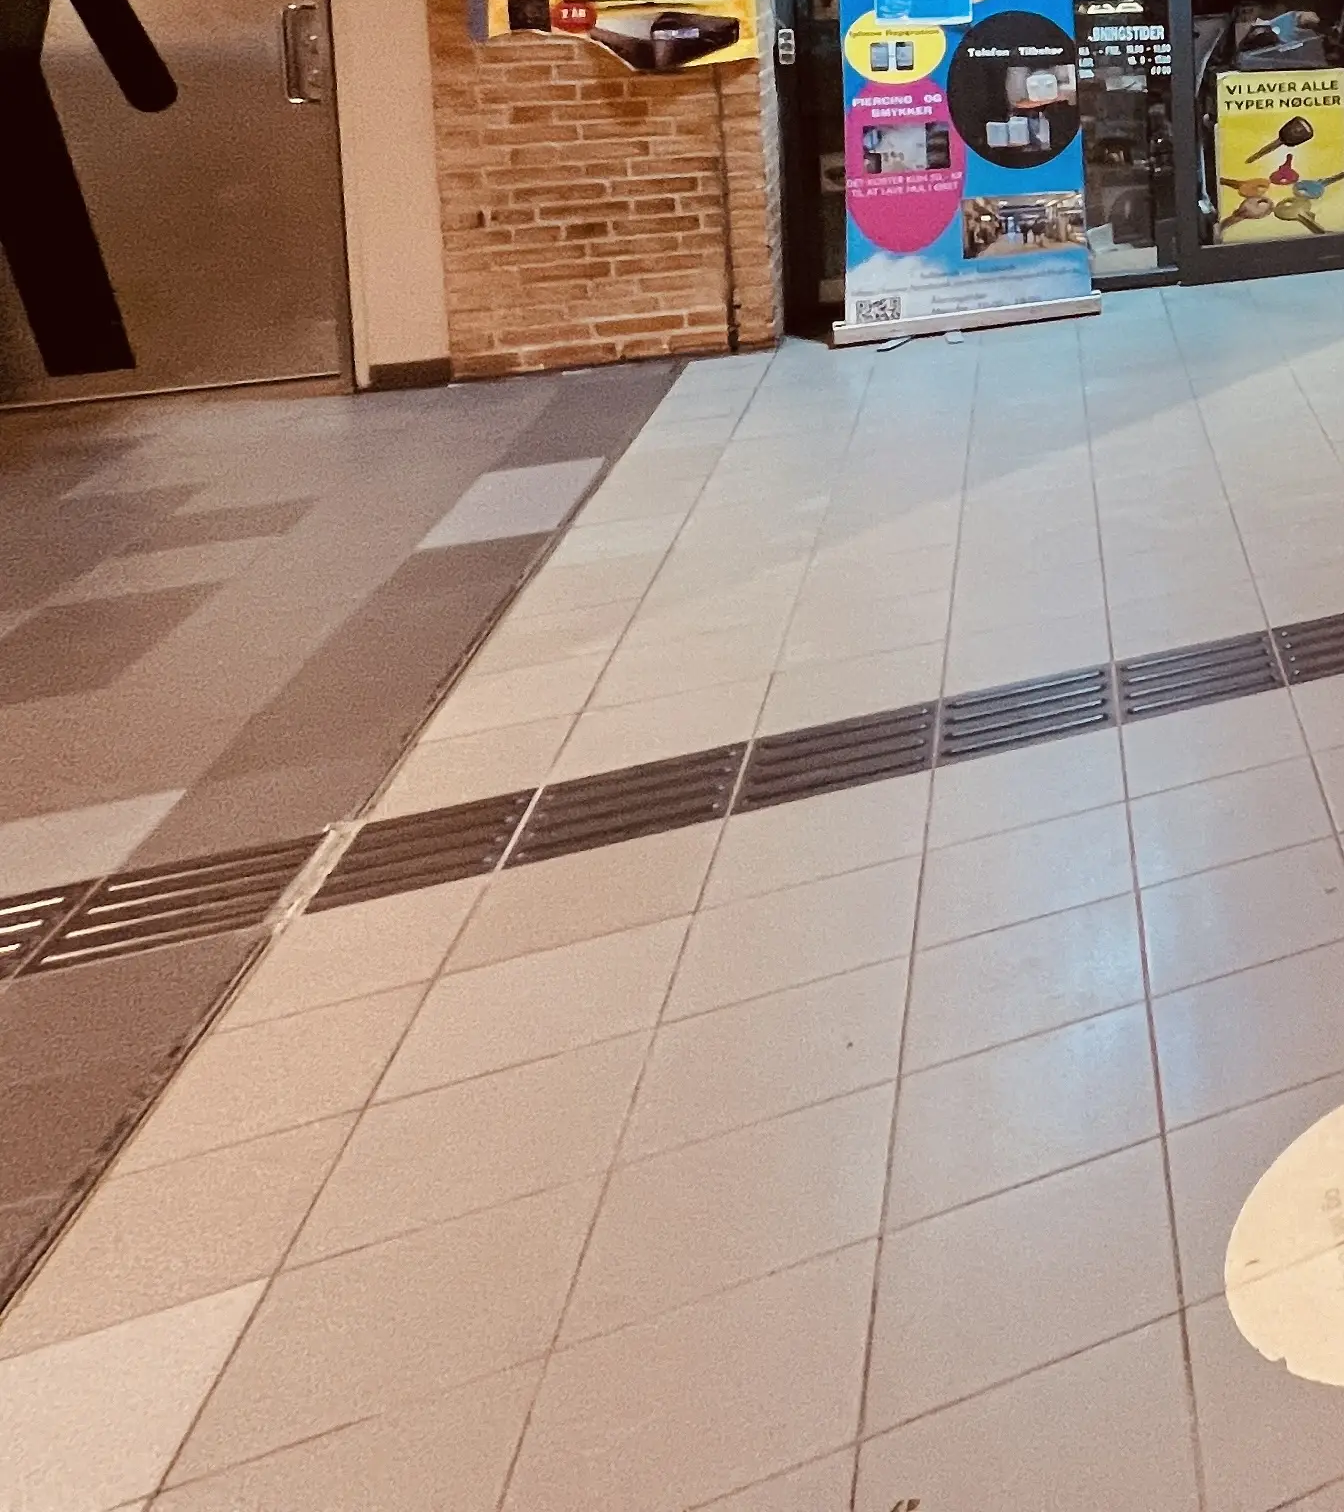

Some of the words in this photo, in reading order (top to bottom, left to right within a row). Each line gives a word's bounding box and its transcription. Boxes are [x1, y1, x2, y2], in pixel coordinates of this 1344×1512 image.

[967, 47, 1010, 59] Telefon
[1225, 84, 1243, 96] VI
[1247, 81, 1298, 95] LAVER
[1302, 79, 1339, 92] ALLE
[852, 94, 913, 107] PIERCING
[1224, 98, 1275, 111] TYPER
[1279, 95, 1342, 109] NØGLER
